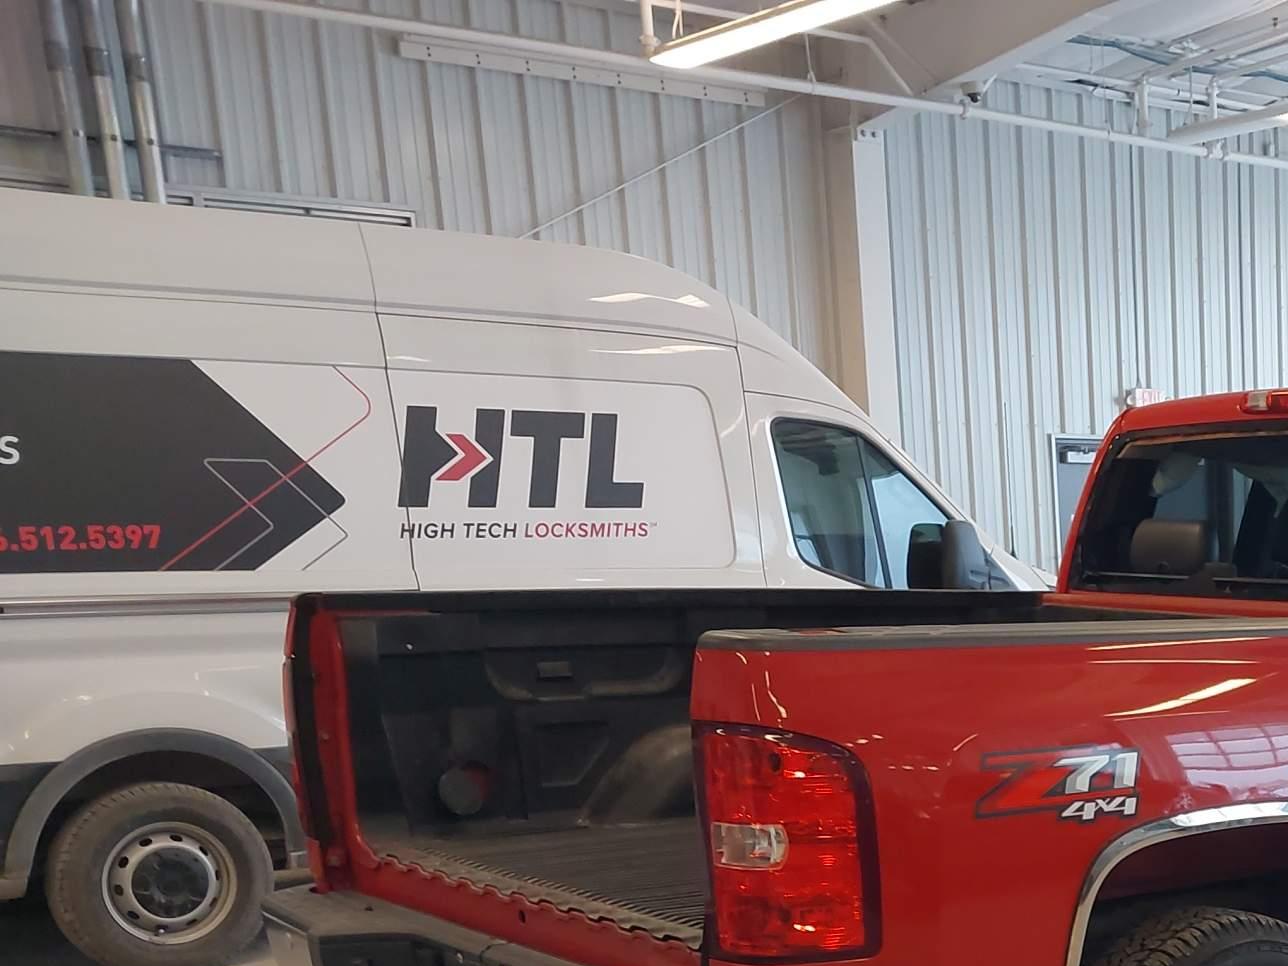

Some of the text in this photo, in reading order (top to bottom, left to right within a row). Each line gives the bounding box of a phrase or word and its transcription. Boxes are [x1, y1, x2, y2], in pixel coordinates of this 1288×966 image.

[398, 405, 644, 508] HTL
[400, 522, 649, 538] HIGH TECH LOCKSMITHS
[976, 743, 1139, 818] Z71
